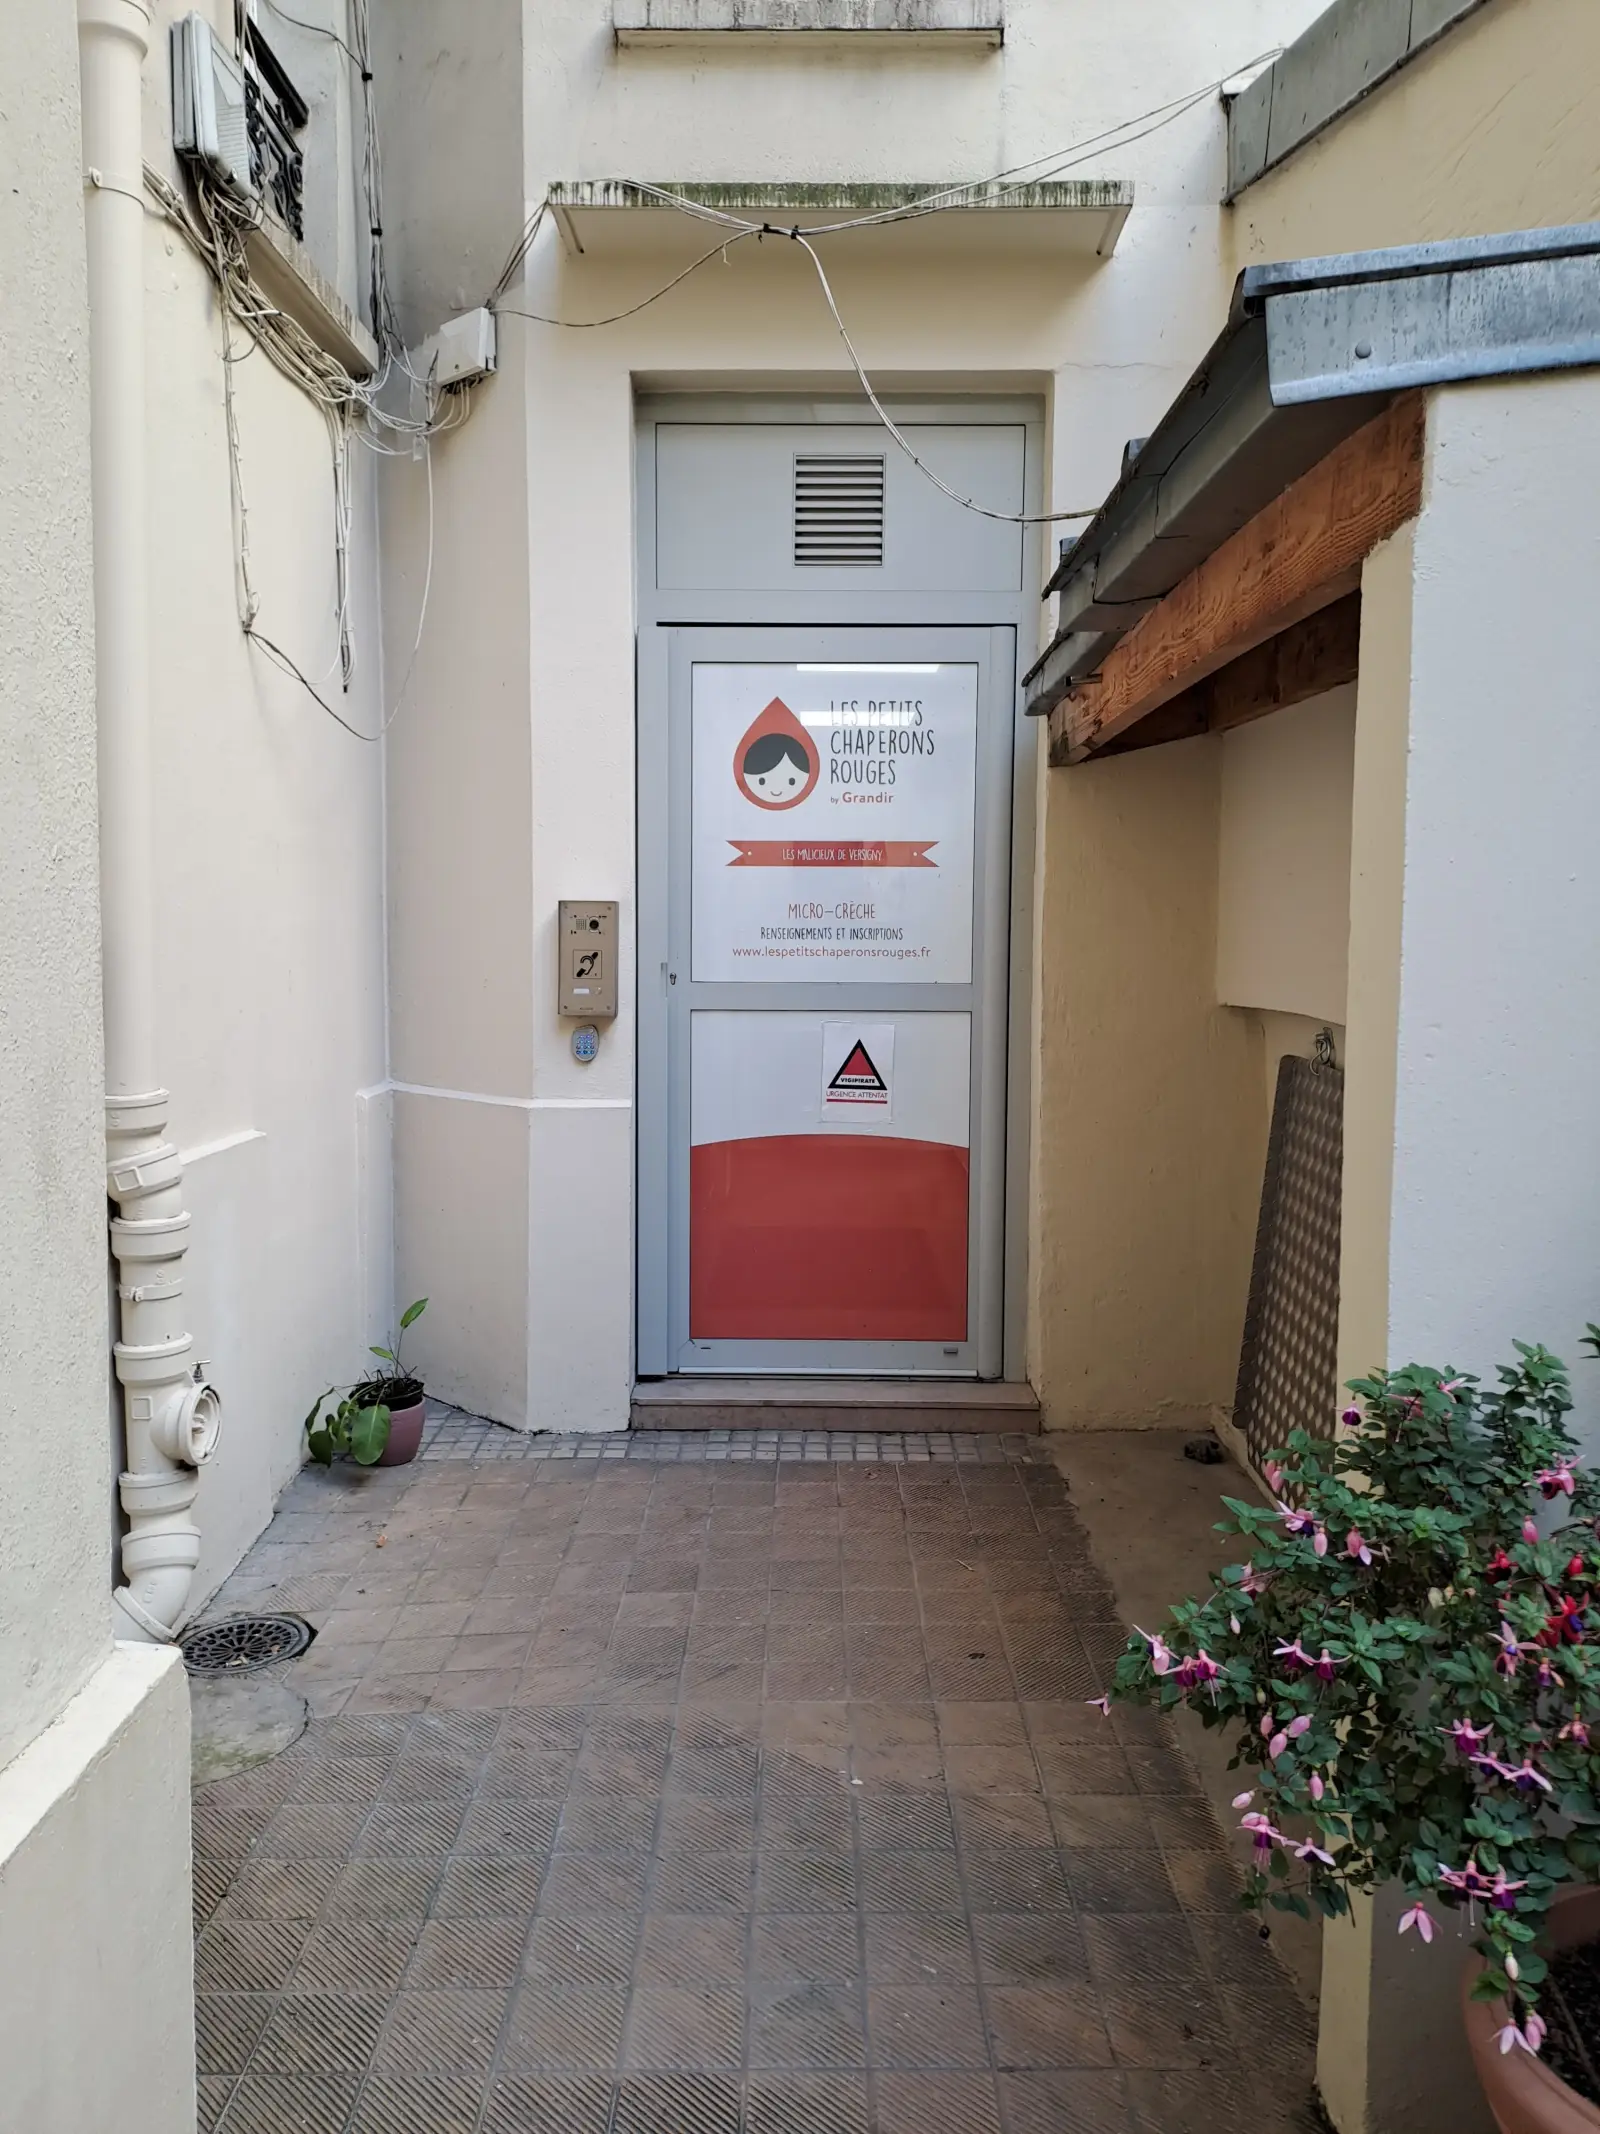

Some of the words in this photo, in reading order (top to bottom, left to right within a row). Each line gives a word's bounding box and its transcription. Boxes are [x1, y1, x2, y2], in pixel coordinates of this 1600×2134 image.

[830, 700, 858, 727] LES
[868, 700, 923, 727] PETITS
[830, 728, 935, 756] CHAPERONS
[830, 758, 896, 785] ROUGES
[830, 796, 839, 805] by
[842, 791, 894, 804] Grandir
[782, 848, 795, 860] LES
[797, 848, 835, 861] MALICIEUX
[837, 849, 846, 860] DE
[848, 848, 883, 862] VERSIGNY
[760, 926, 832, 941] RENSEIGNEMENTS
[836, 927, 845, 940] ET
[849, 927, 904, 941] INSCRIPTIONS
[732, 945, 932, 960] www.lespetitschaperonsrouges.fr
